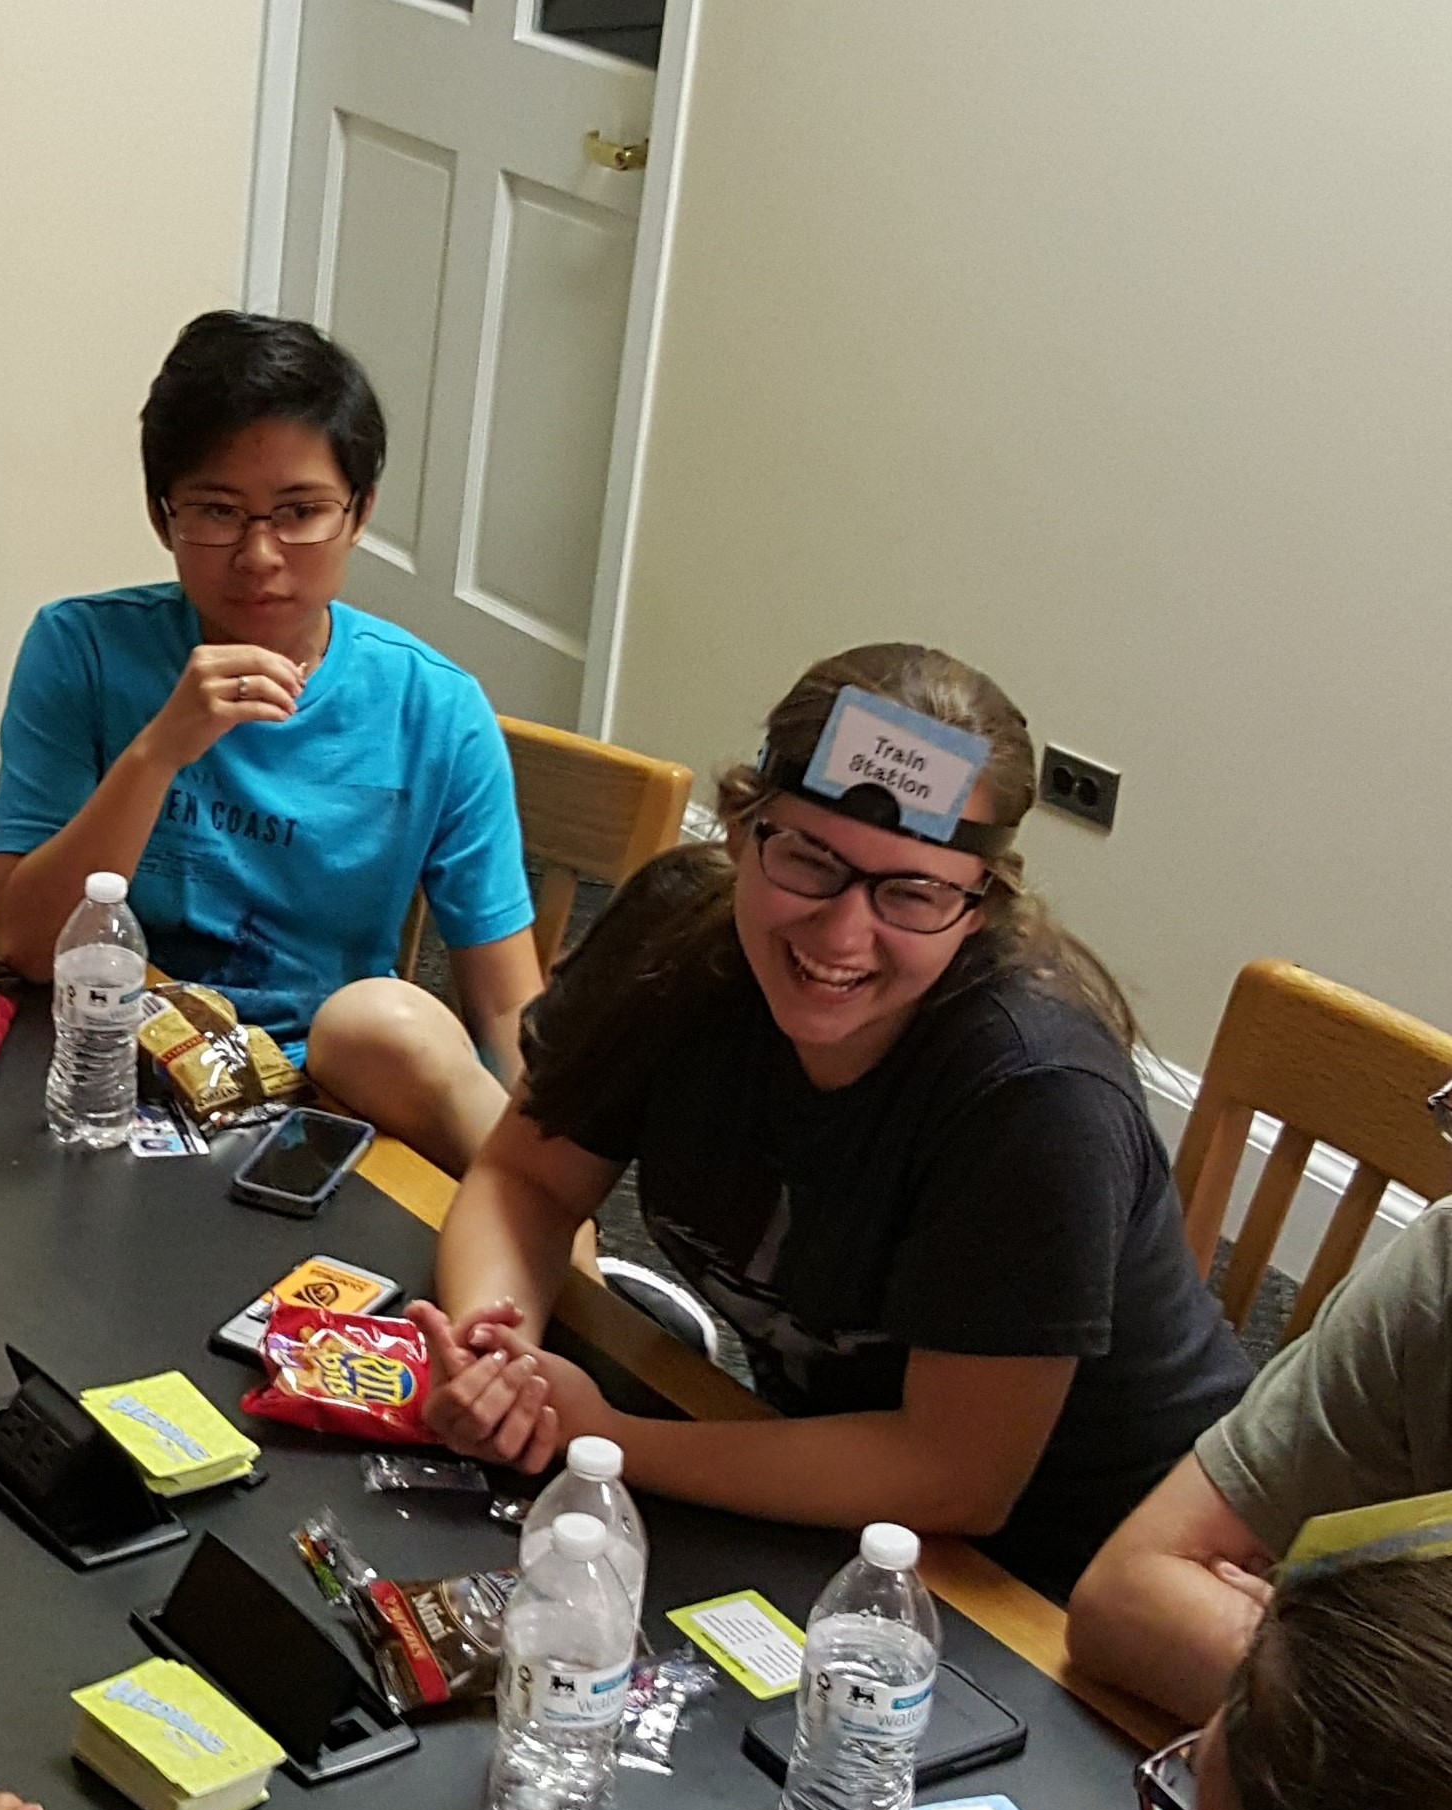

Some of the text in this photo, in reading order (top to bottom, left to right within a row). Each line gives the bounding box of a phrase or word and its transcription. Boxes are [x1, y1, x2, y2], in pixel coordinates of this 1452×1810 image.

[849, 754, 931, 800] Station
[874, 735, 926, 772] Train
[164, 788, 298, 847] EN COAST
[411, 1591, 455, 1642] Mini
